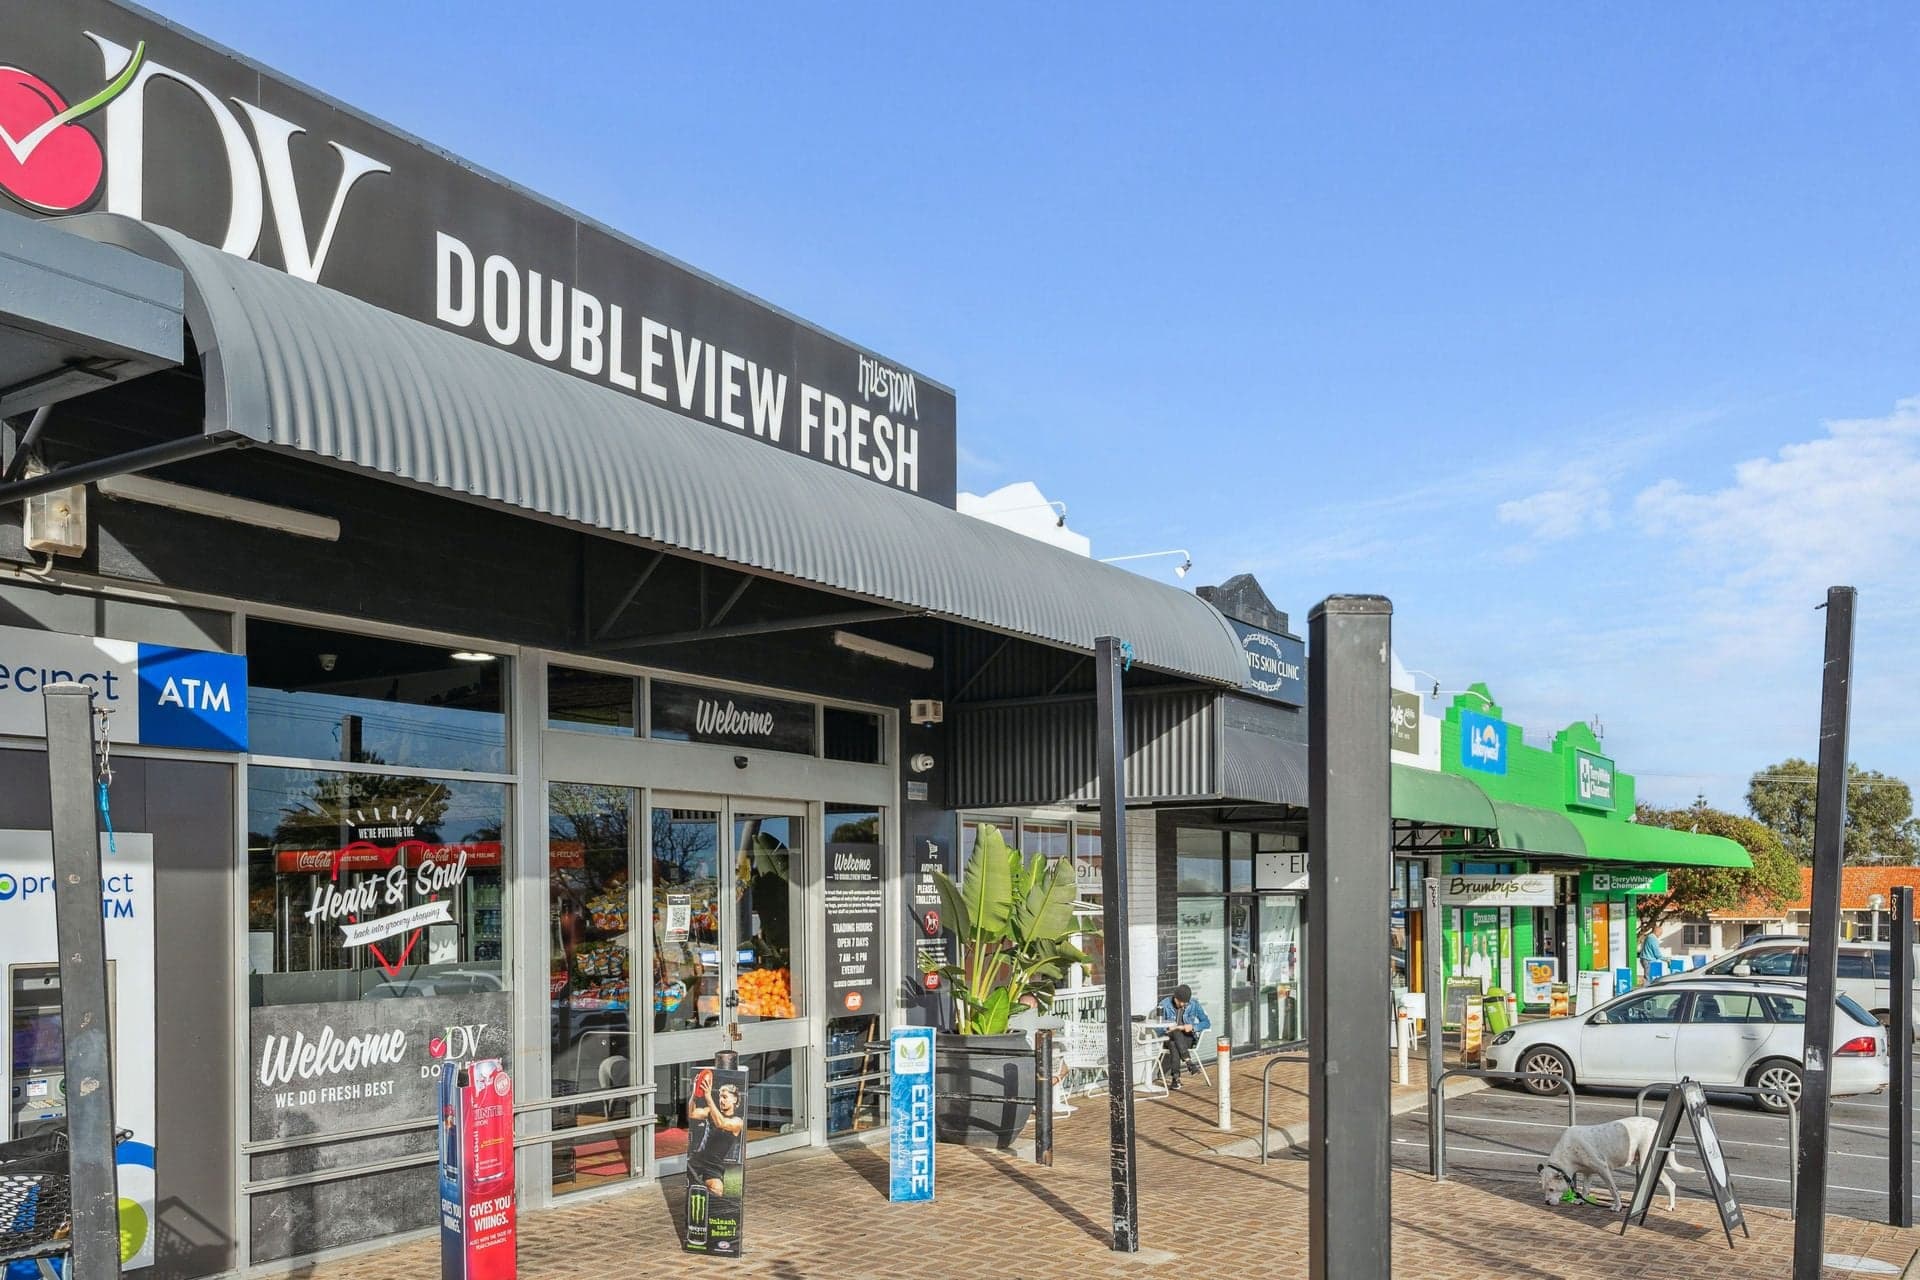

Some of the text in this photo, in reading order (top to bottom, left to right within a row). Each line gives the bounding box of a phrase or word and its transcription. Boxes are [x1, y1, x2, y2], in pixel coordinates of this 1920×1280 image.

[83, 30, 391, 284] DV
[436, 230, 919, 492] DOUBLEVIEW FRESH
[1261, 655, 1277, 674] SKIN
[1277, 660, 1300, 680] CLINIC
[158, 676, 231, 713] ATM
[695, 698, 775, 736] Welcome
[358, 826, 415, 839] WE'RE PUTTING THE
[834, 852, 871, 871] Welcome
[304, 850, 467, 924] Heart & Soul
[917, 884, 933, 894] PLEASE
[1449, 877, 1520, 898] Brumby's
[1611, 875, 1652, 884] TerryWhite
[915, 895, 937, 905] TROLLEYS
[371, 923, 385, 934] into
[385, 915, 410, 935] grocery
[410, 907, 441, 927] shopping
[832, 922, 873, 933] TRADING HOURS
[837, 937, 869, 948] OPEN 7 DAYS
[843, 953, 851, 962] AM
[859, 952, 868, 961] PM
[841, 964, 866, 975] EVERYDAY
[444, 1024, 488, 1061] DV
[260, 1025, 408, 1087] Welcome
[275, 1080, 394, 1108] WE DO FRESH BEST
[912, 1084, 928, 1142] ECO
[912, 1149, 928, 1194] ICE
[469, 1195, 511, 1218] GIVES YOU
[709, 1217, 737, 1226] Unleash
